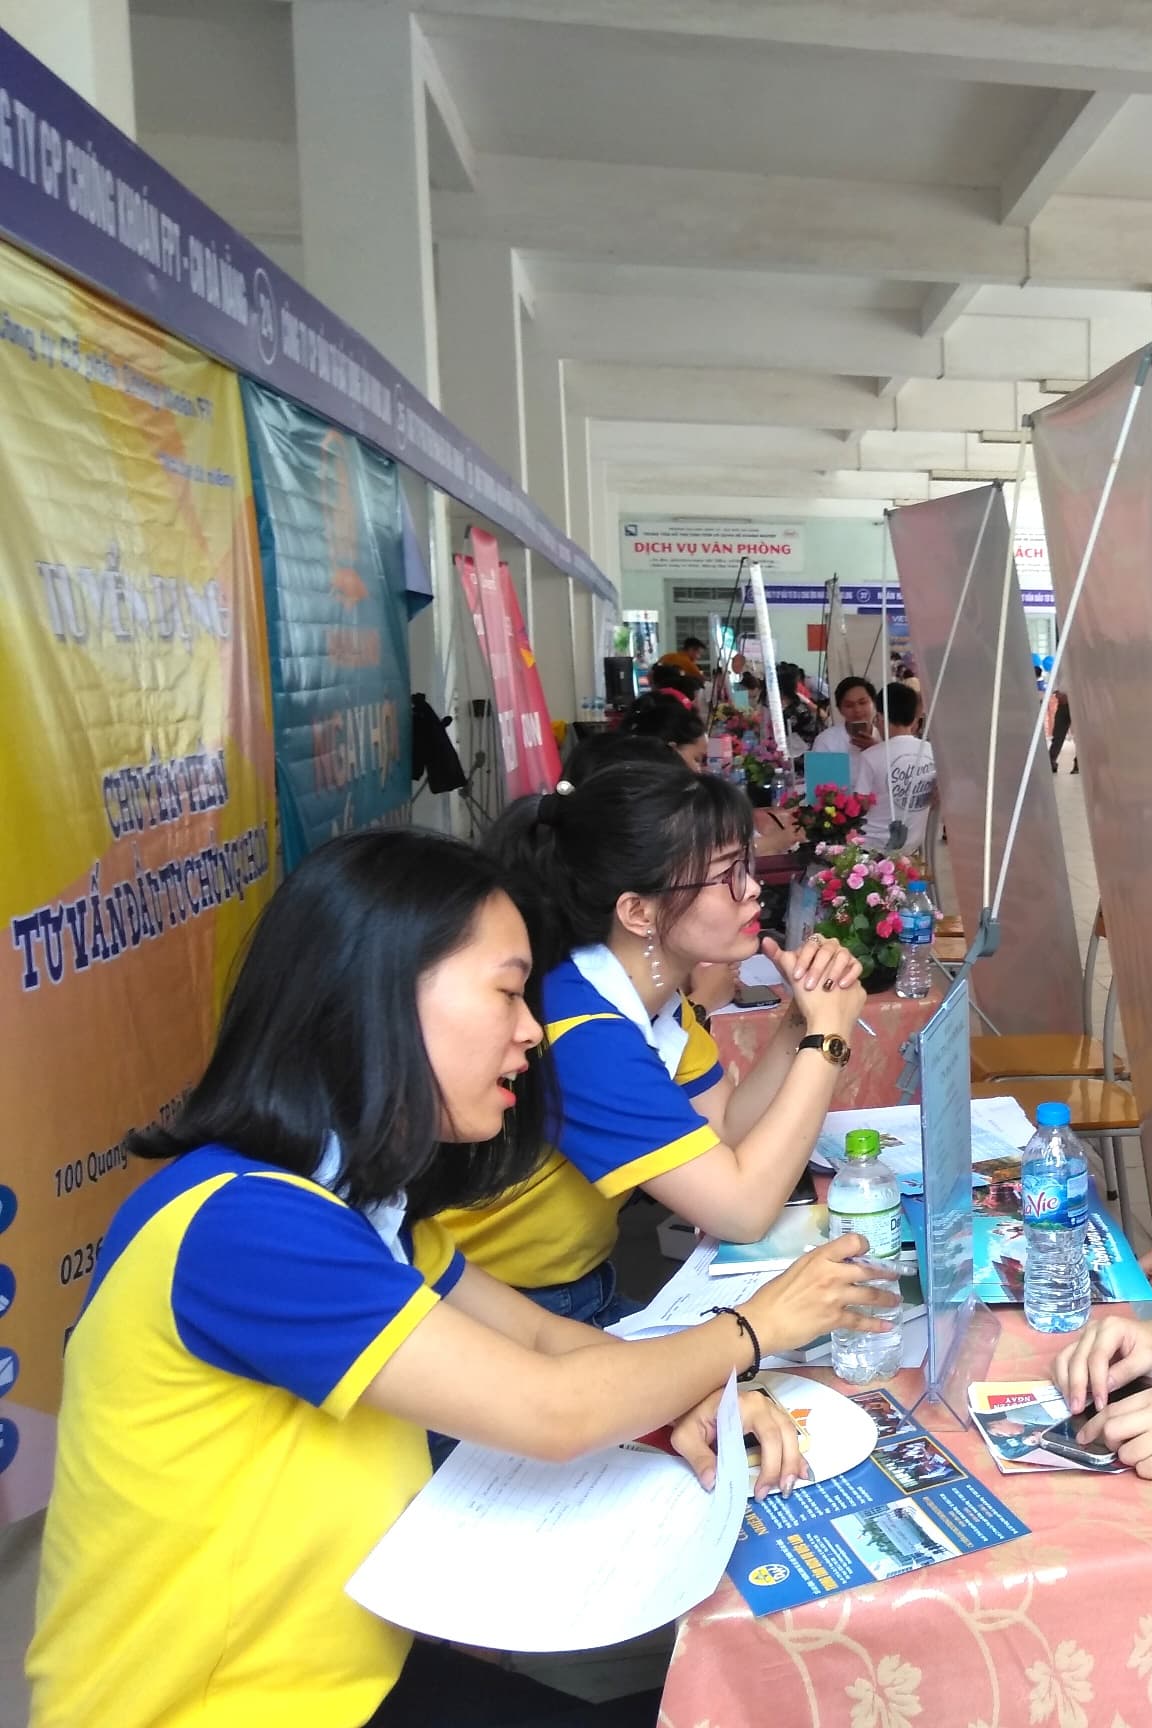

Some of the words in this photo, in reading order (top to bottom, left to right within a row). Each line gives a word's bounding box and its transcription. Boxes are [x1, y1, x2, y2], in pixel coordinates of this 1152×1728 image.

[14, 98, 36, 184] TY
[41, 119, 62, 199] CP
[160, 212, 180, 282] FPT
[634, 542, 672, 556] DỊCH
[677, 542, 697, 556] VỤ
[737, 541, 792, 555] PHÒNG
[1015, 545, 1044, 558] ÁCH
[12, 904, 63, 990] TƯ
[65, 860, 128, 972] VẤN
[121, 841, 163, 947] ĐẦU
[54, 1159, 84, 1198] 100
[86, 1142, 128, 1182] Quang
[1024, 1191, 1059, 1218] aVie
